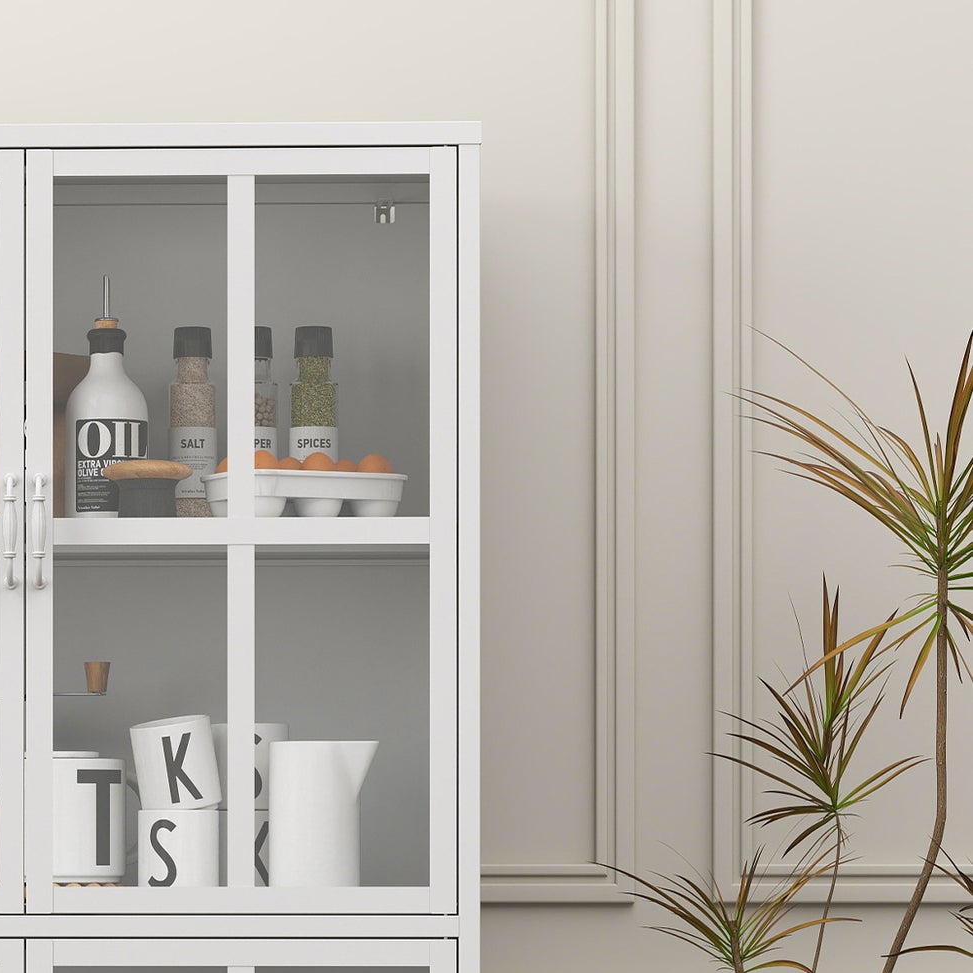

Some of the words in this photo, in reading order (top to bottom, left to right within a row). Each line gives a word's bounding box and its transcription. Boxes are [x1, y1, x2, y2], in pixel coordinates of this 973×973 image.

[78, 420, 147, 459] OIL
[180, 438, 206, 449] SALT
[254, 438, 272, 449] PER
[297, 438, 331, 449] SPICES
[78, 460, 102, 468] EXTRA
[77, 468, 99, 477] OLIVE
[161, 731, 204, 805] K
[76, 769, 122, 867] T
[147, 818, 178, 887] S
